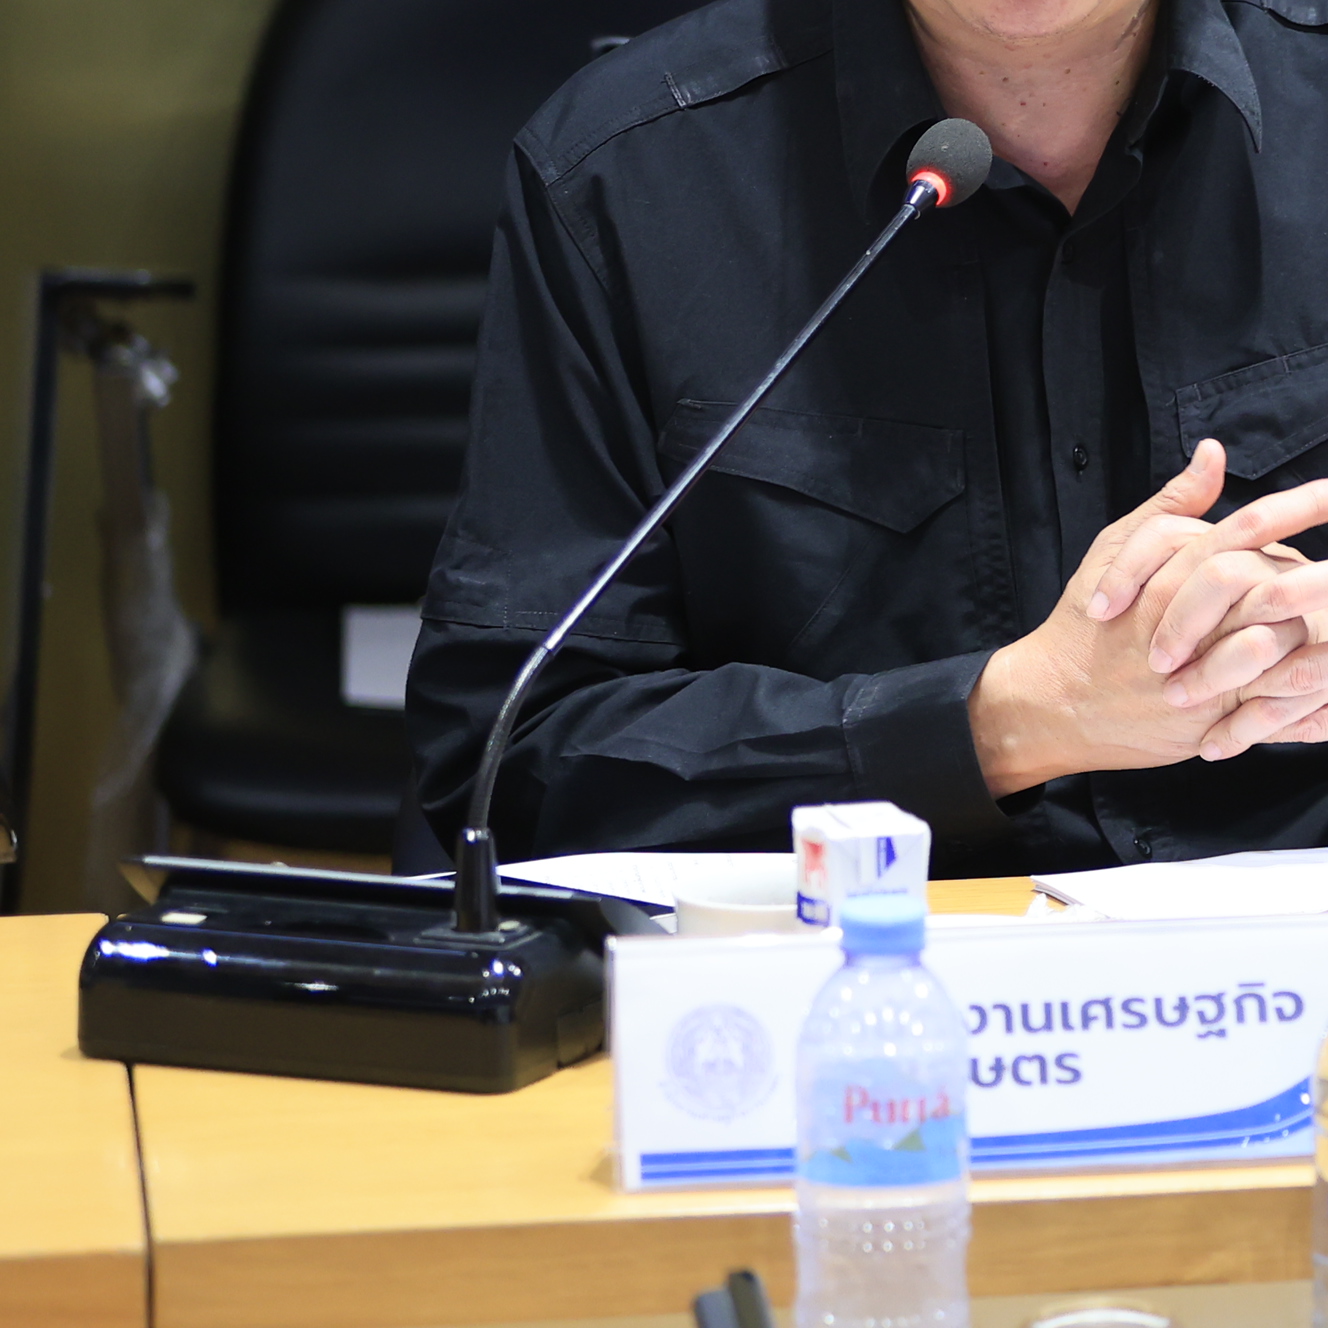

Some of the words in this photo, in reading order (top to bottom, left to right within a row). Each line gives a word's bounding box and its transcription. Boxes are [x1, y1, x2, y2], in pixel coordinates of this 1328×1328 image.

[969, 982, 1305, 1039] งานเศรษฐกิจ
[969, 1052, 1083, 1088] ษตร
